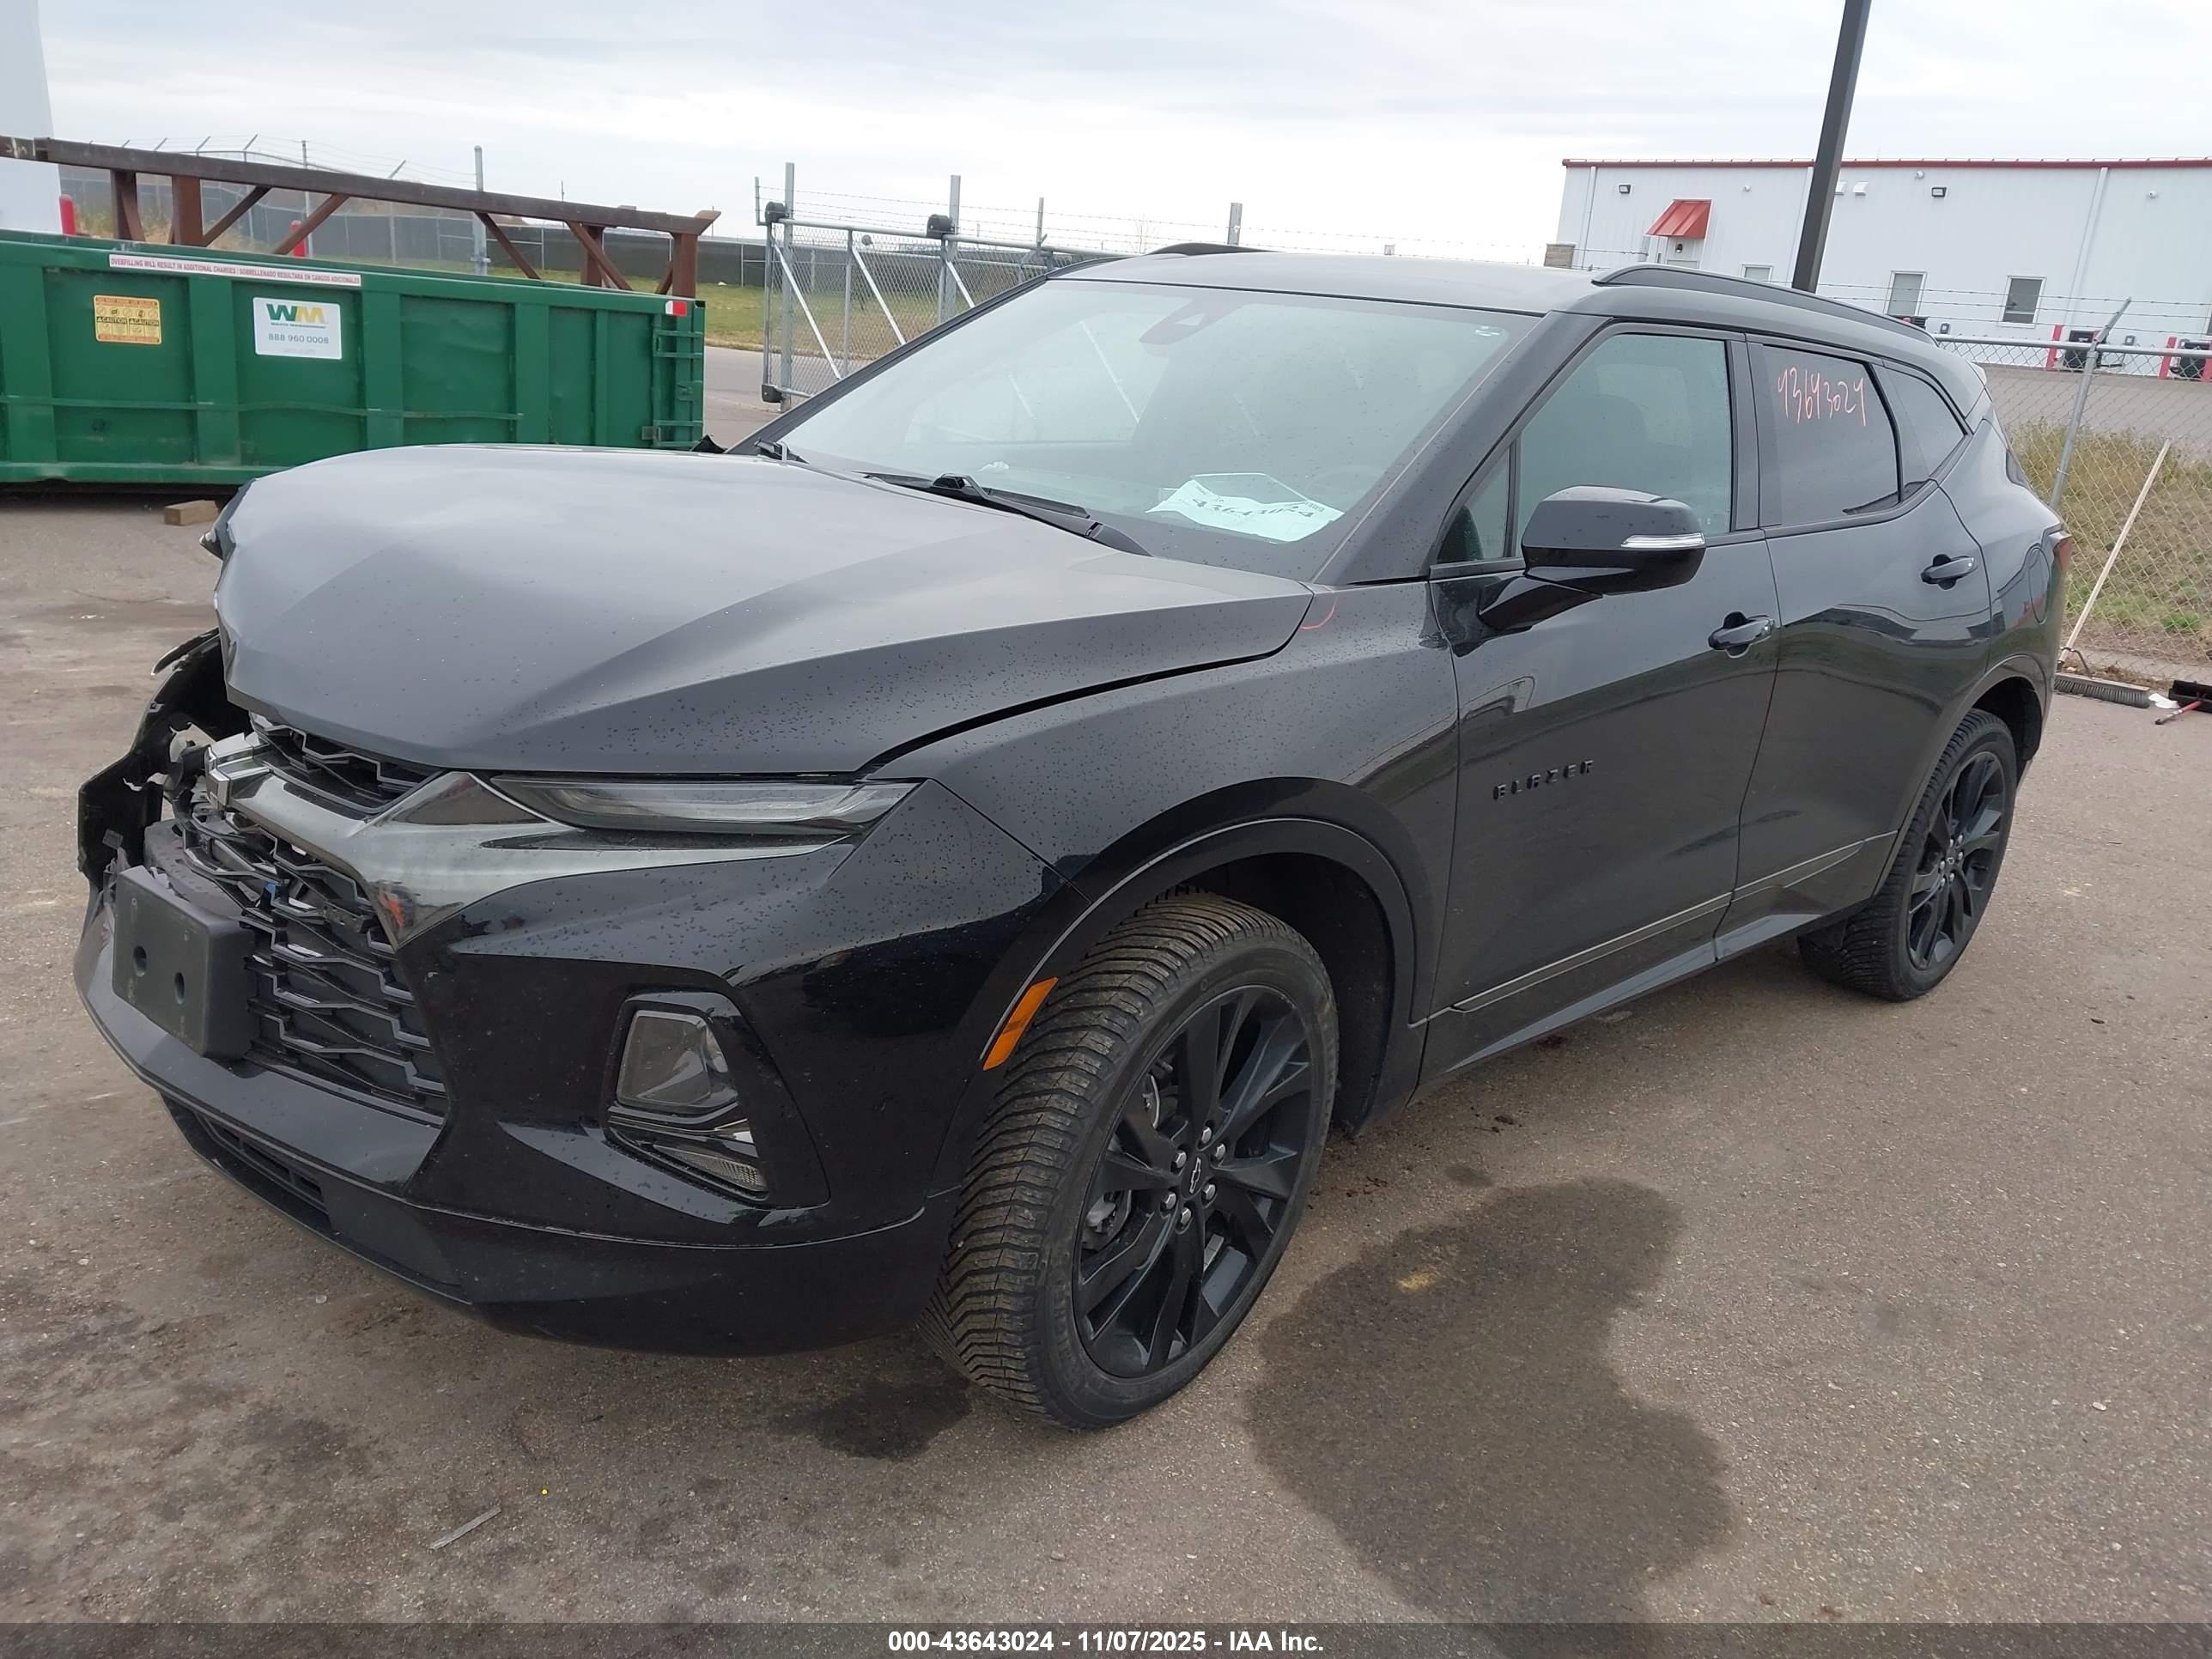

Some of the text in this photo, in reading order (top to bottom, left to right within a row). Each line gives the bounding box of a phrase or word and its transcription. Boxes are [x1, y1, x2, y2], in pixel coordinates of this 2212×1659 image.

[184, 264, 212, 272] ADDITIONAL
[312, 274, 330, 283] CARGOS
[266, 303, 325, 324] WM
[288, 334, 305, 343] 960
[1493, 760, 1594, 800] BLAZER
